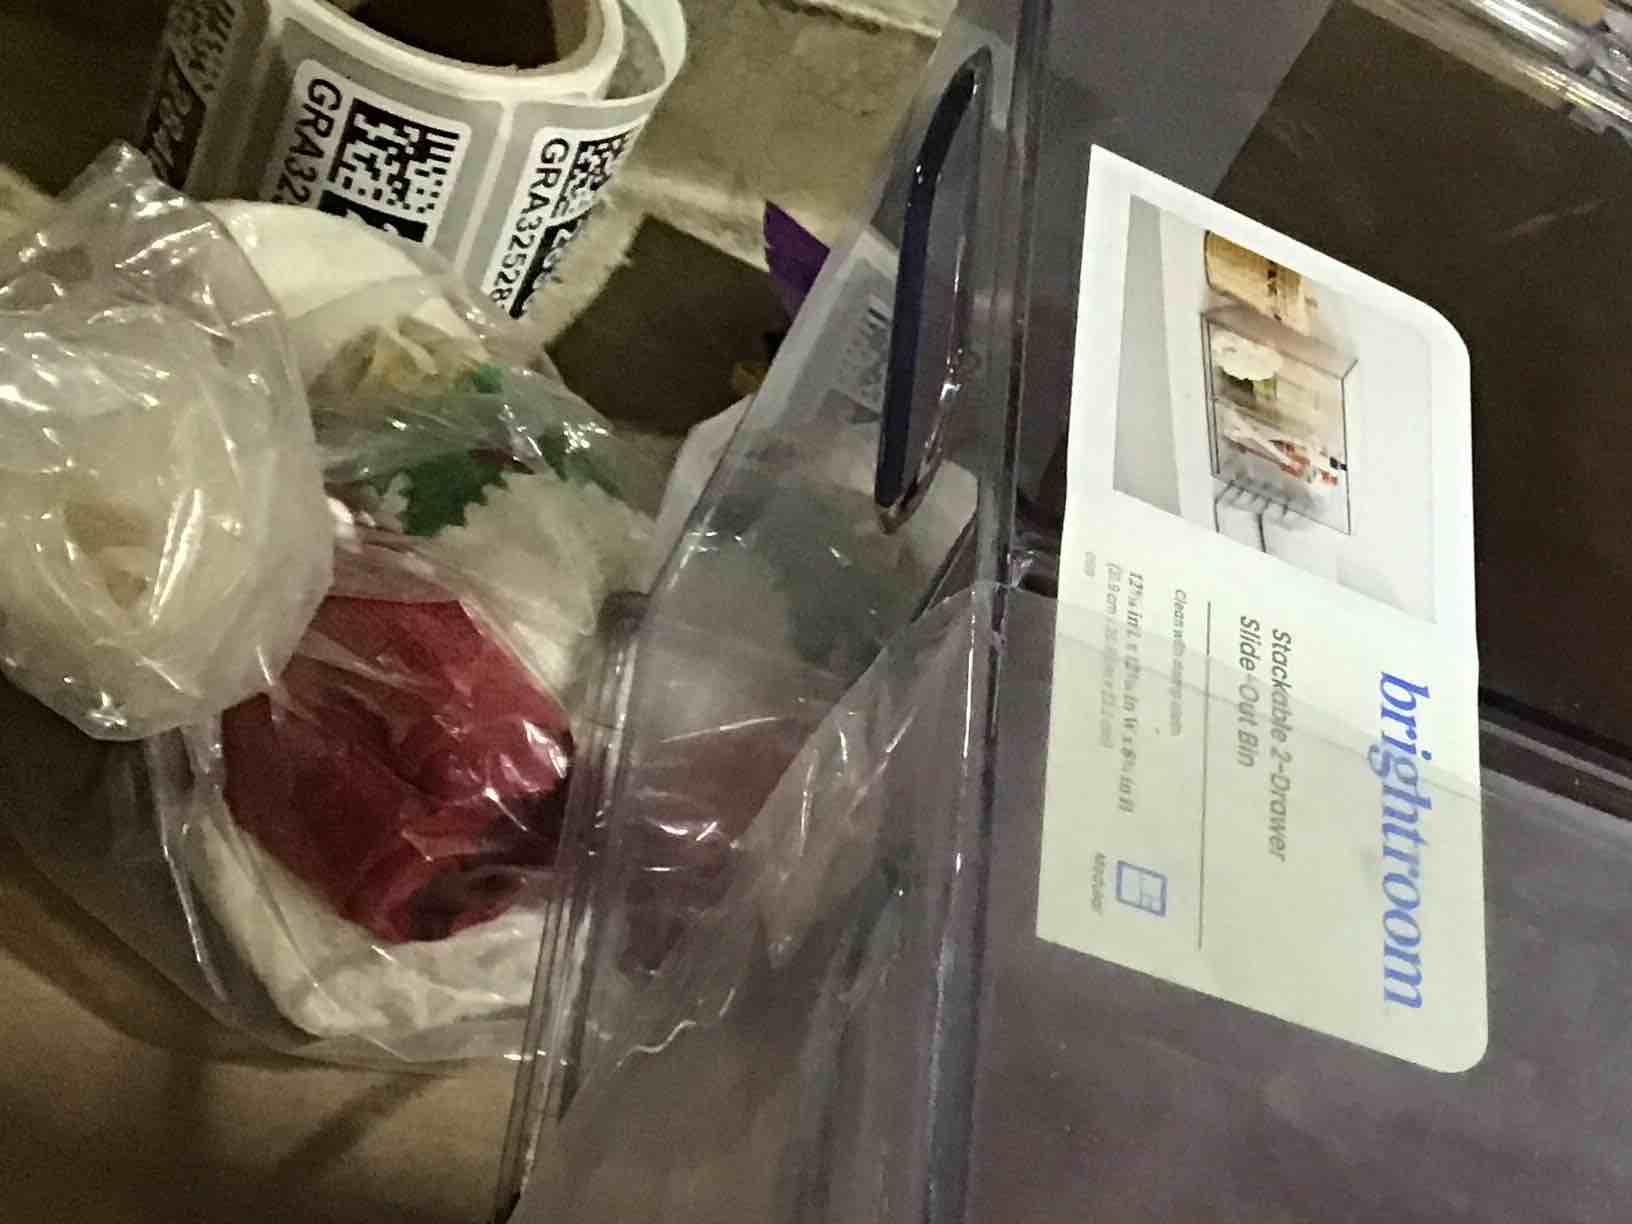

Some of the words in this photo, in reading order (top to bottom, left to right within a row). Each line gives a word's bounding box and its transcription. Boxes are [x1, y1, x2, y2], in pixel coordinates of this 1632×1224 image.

[272, 78, 343, 206] GRA32
[490, 137, 570, 309] GRA32528
[1173, 588, 1190, 627] Clean
[1237, 616, 1262, 727] Slide-Out
[1270, 628, 1293, 744] Stackable
[1236, 730, 1260, 768] Bin
[1267, 746, 1292, 863] 2-Drawer
[1367, 671, 1433, 1010] brightroom
